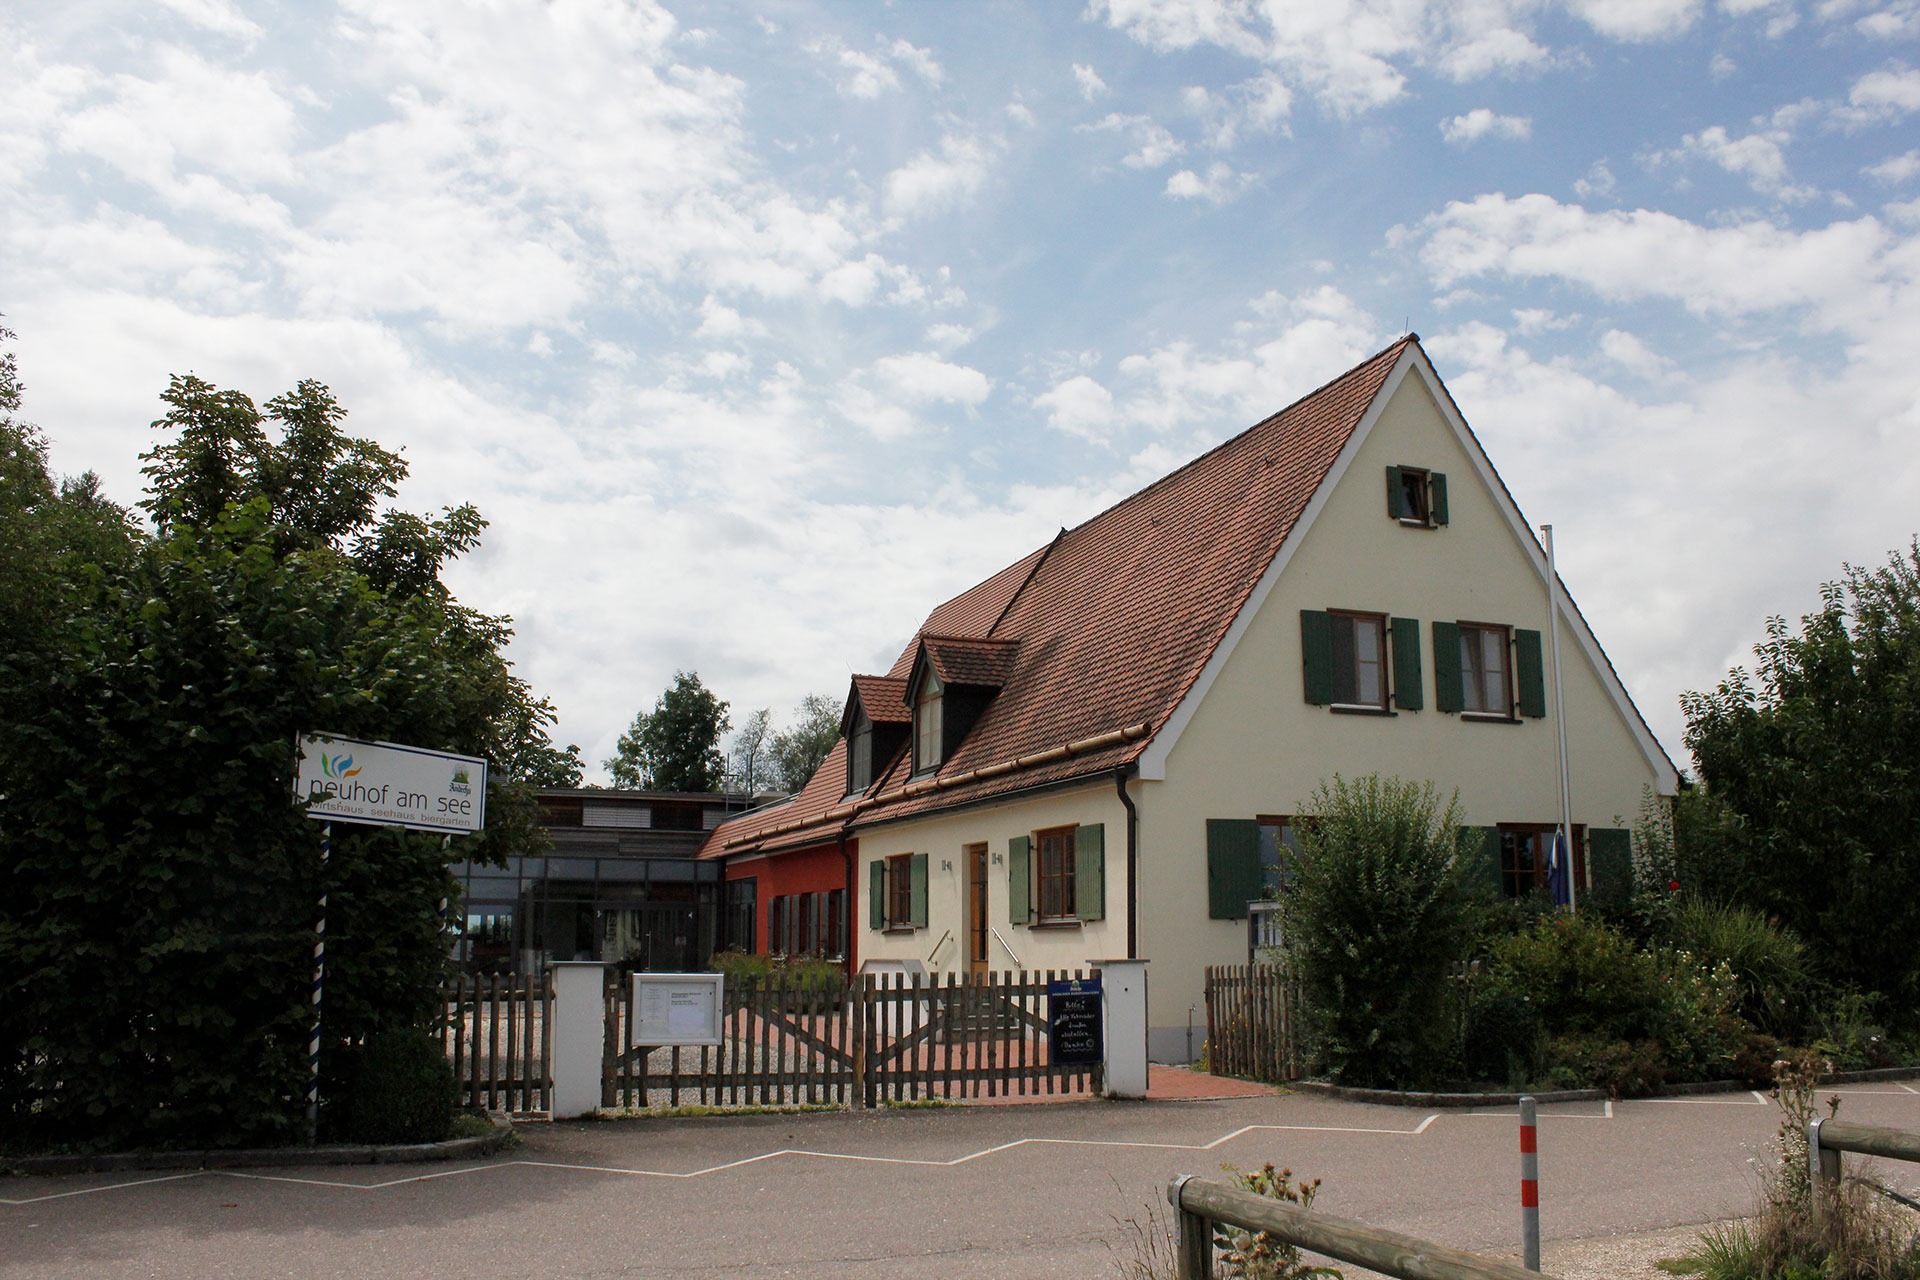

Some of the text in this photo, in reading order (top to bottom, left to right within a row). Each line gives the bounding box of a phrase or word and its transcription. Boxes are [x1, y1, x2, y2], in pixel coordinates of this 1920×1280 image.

[310, 779, 471, 815] neuhof am see
[310, 802, 471, 826] wirtshaus seehaus biergarten
